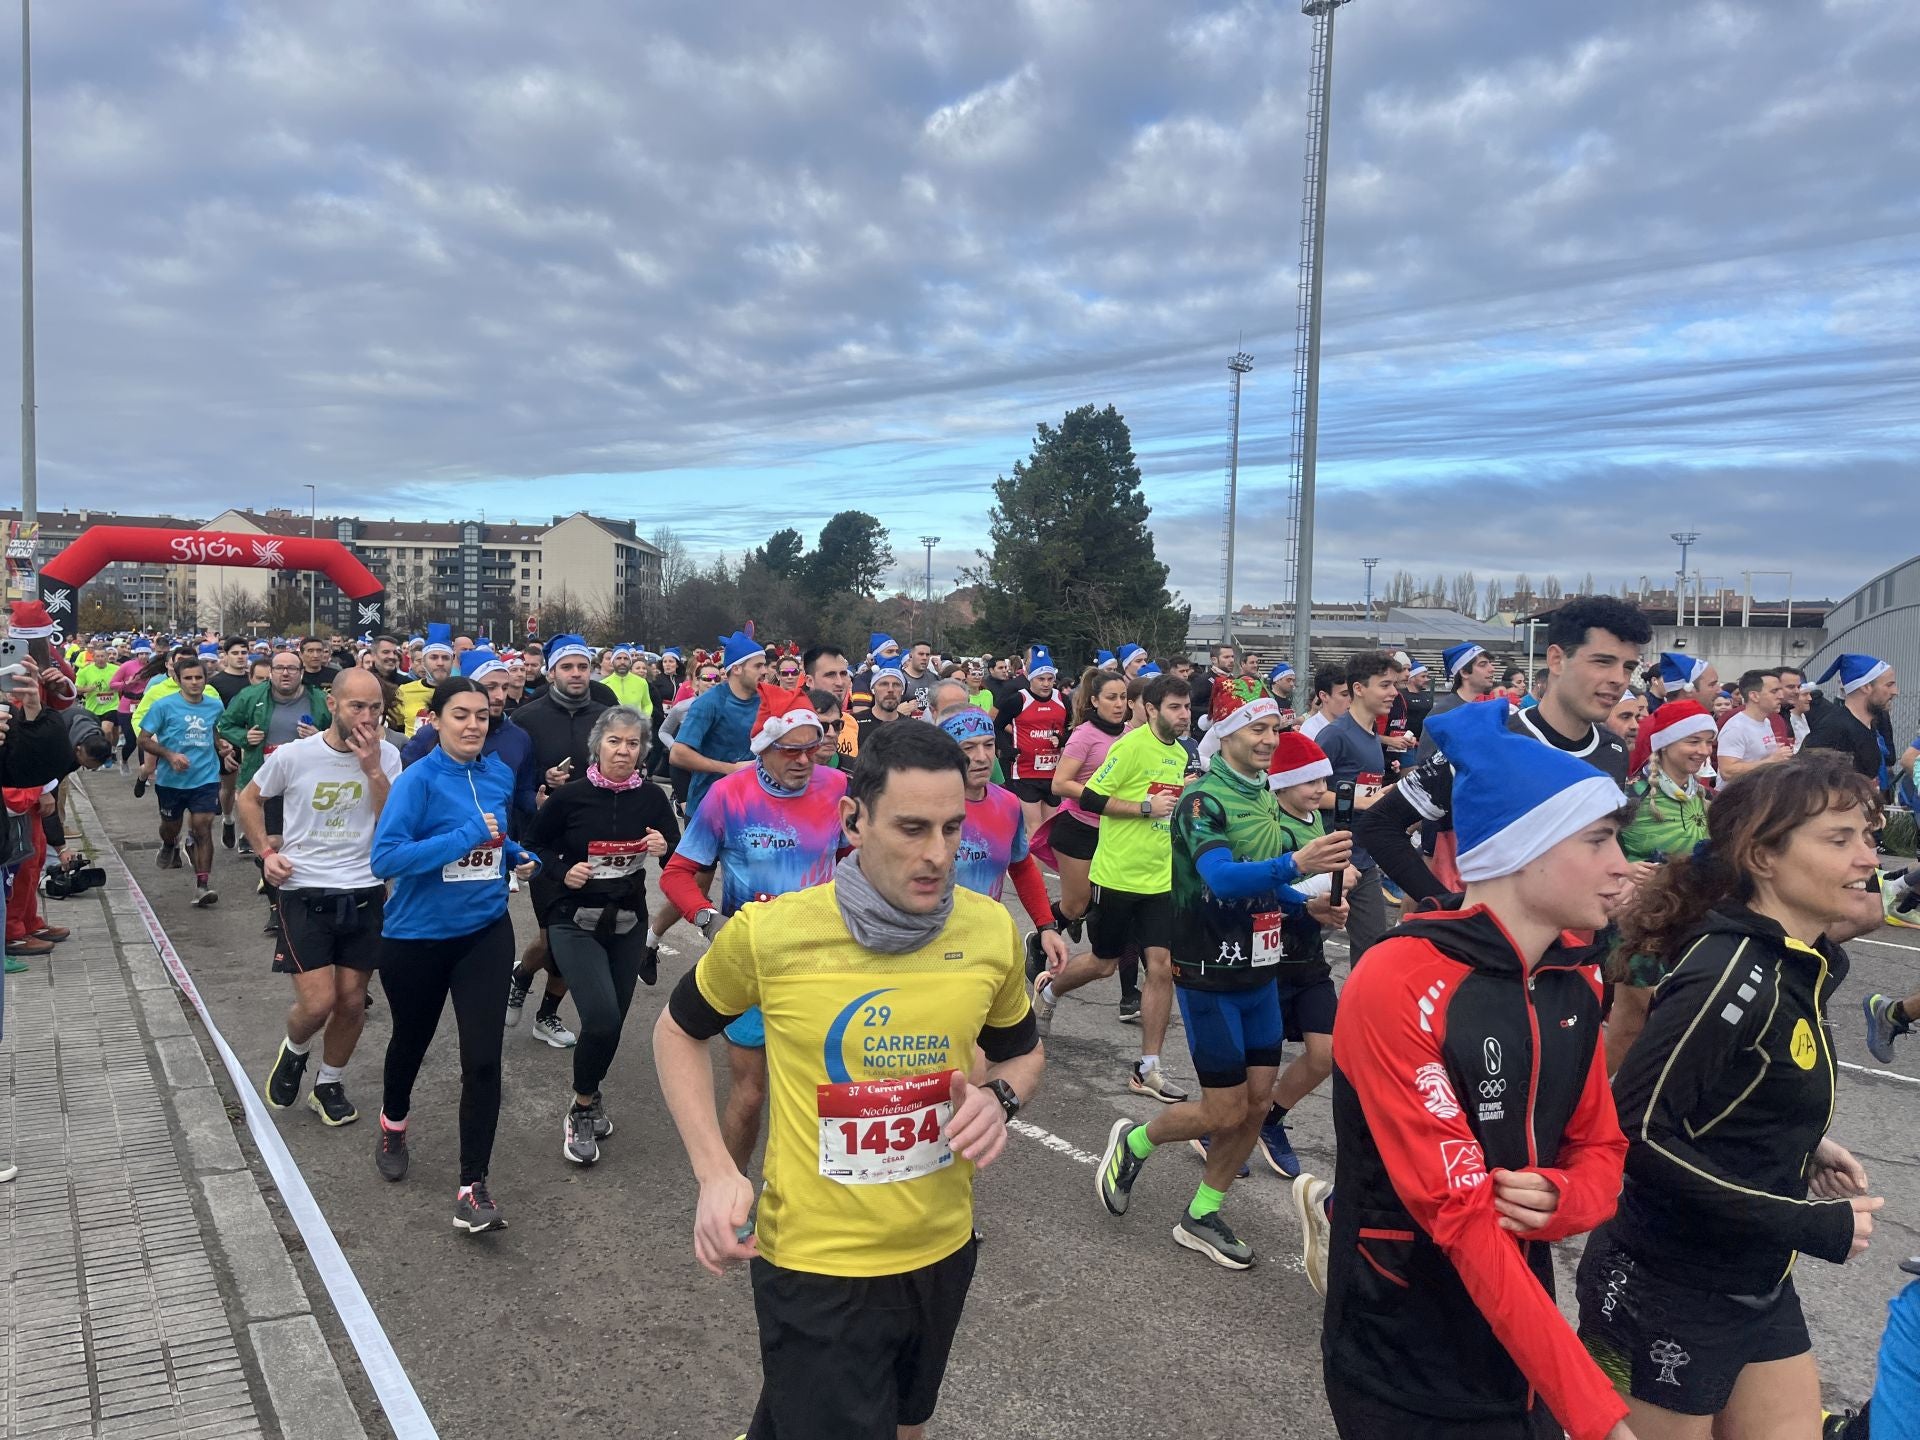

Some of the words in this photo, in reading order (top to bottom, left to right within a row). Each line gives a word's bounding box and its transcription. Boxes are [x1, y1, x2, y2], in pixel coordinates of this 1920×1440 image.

[6, 548, 32, 558] NAVIDAD
[171, 536, 243, 562] gijón
[1096, 757, 1118, 783] LEGEA
[458, 850, 494, 868] 388
[601, 854, 638, 867] 387
[863, 1005, 892, 1027] 29
[863, 1034, 951, 1052] CARRERA
[863, 1051, 947, 1068] NOCTURNA
[848, 1086, 860, 1097] 37
[905, 1078, 940, 1091] Popular
[890, 1094, 902, 1103] de
[860, 1101, 923, 1118] Nochebuena
[838, 1108, 940, 1155] 1434
